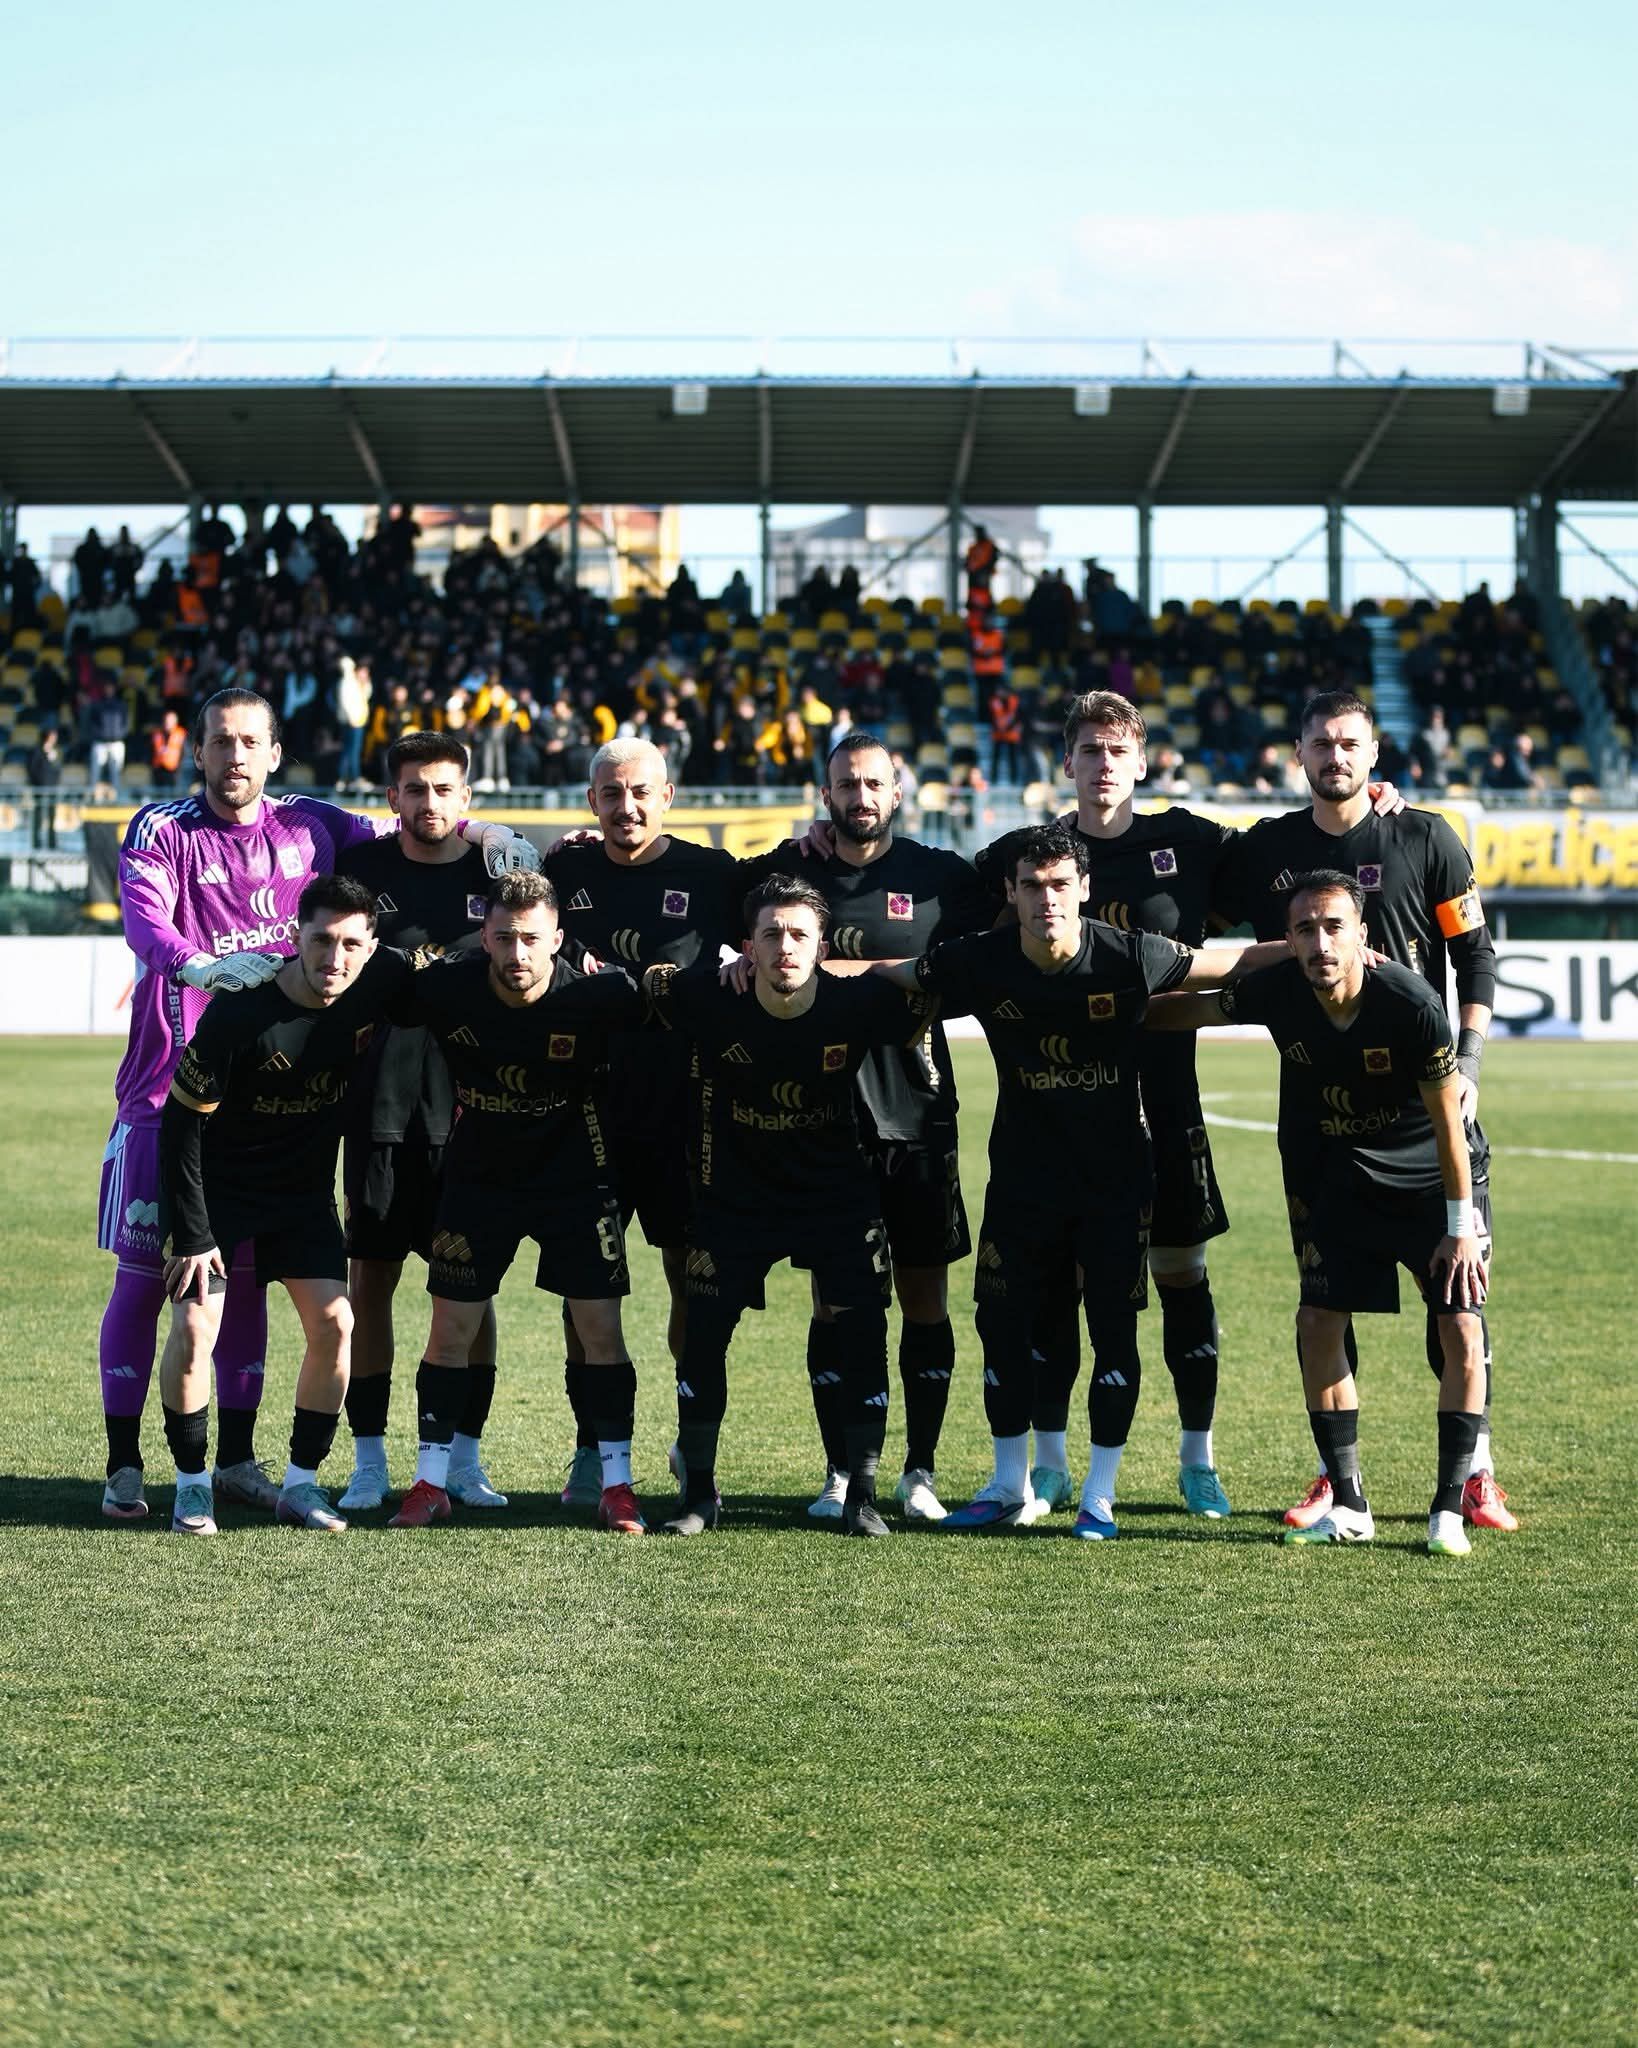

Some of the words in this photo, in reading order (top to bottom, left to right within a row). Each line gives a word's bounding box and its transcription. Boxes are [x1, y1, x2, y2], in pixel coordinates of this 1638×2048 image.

[212, 913, 300, 956] ishakoğ
[167, 982, 185, 1047] ZBETON
[924, 1026, 940, 1086] BETON
[865, 1228, 888, 1273] 2
